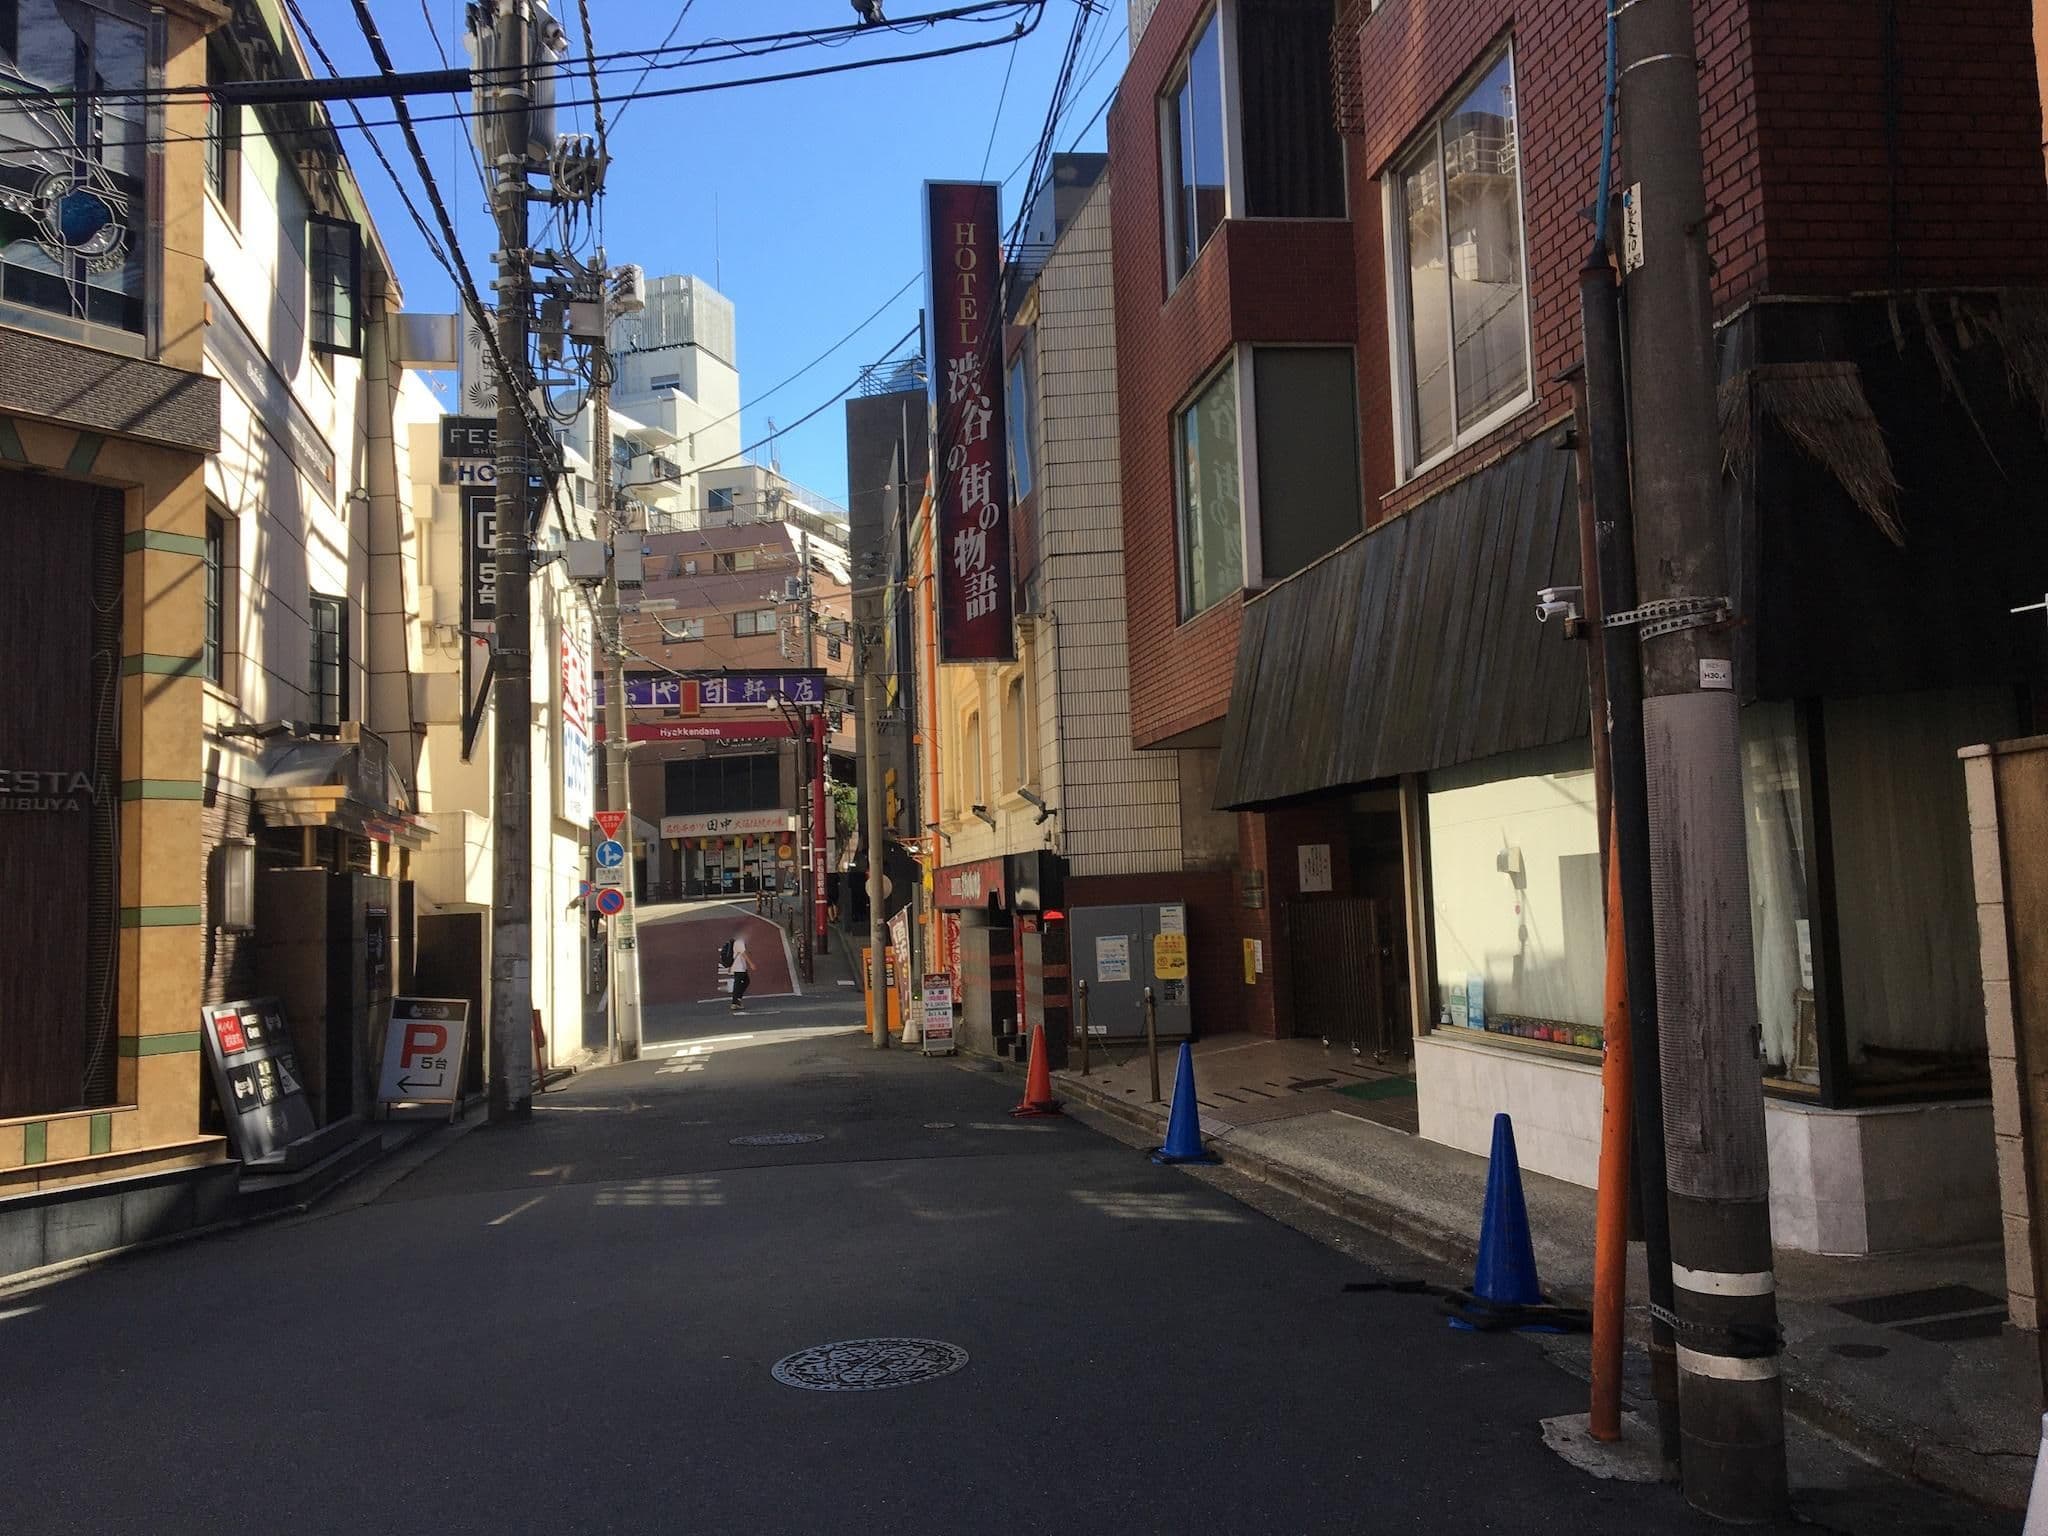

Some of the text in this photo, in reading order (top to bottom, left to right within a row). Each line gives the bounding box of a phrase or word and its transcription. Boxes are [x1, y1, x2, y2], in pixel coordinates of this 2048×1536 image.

[952, 222, 978, 345] HOTEL
[946, 350, 1000, 622] 渋谷の街の物語
[400, 1023, 448, 1069] P
[420, 1056, 448, 1071] 5台
